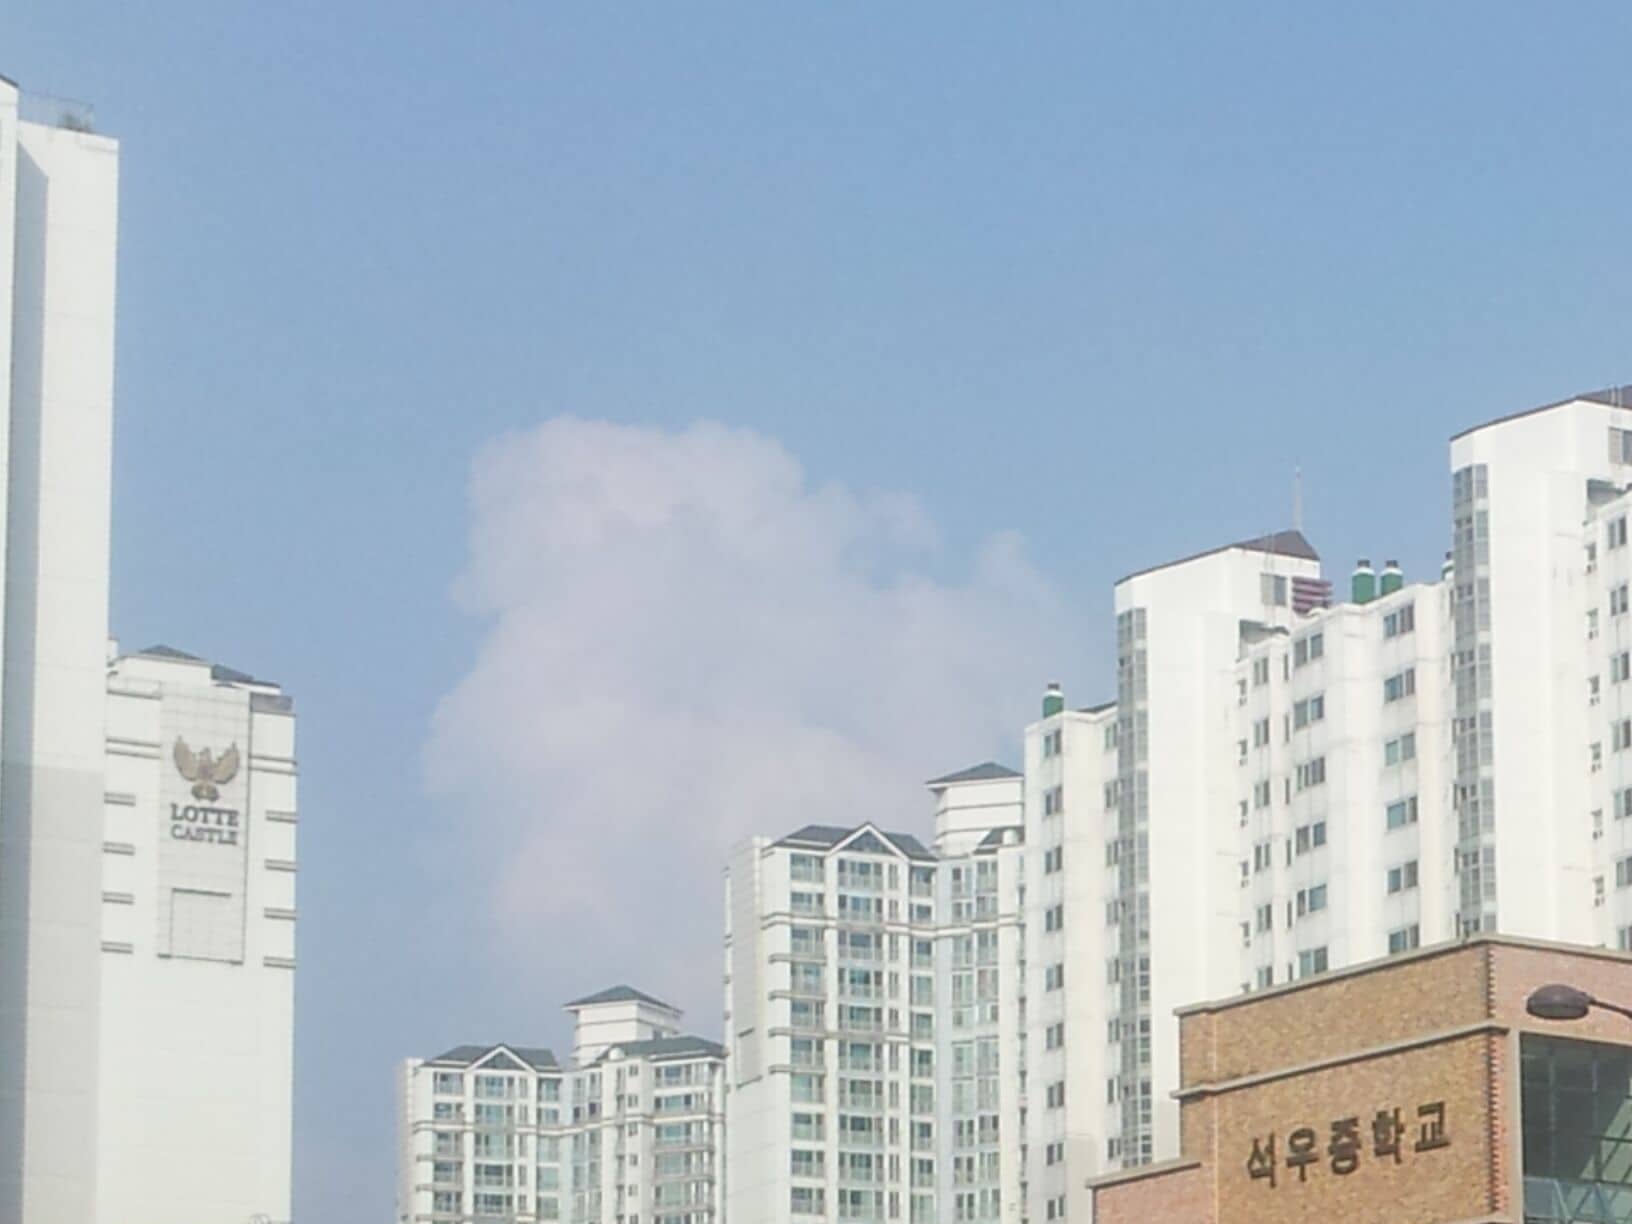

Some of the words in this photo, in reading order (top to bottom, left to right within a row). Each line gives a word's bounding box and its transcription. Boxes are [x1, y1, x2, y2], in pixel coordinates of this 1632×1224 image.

[170, 803, 239, 826] LOTTE
[170, 825, 238, 846] CASTLE
[1247, 1101, 1452, 1189] 석우중학교
